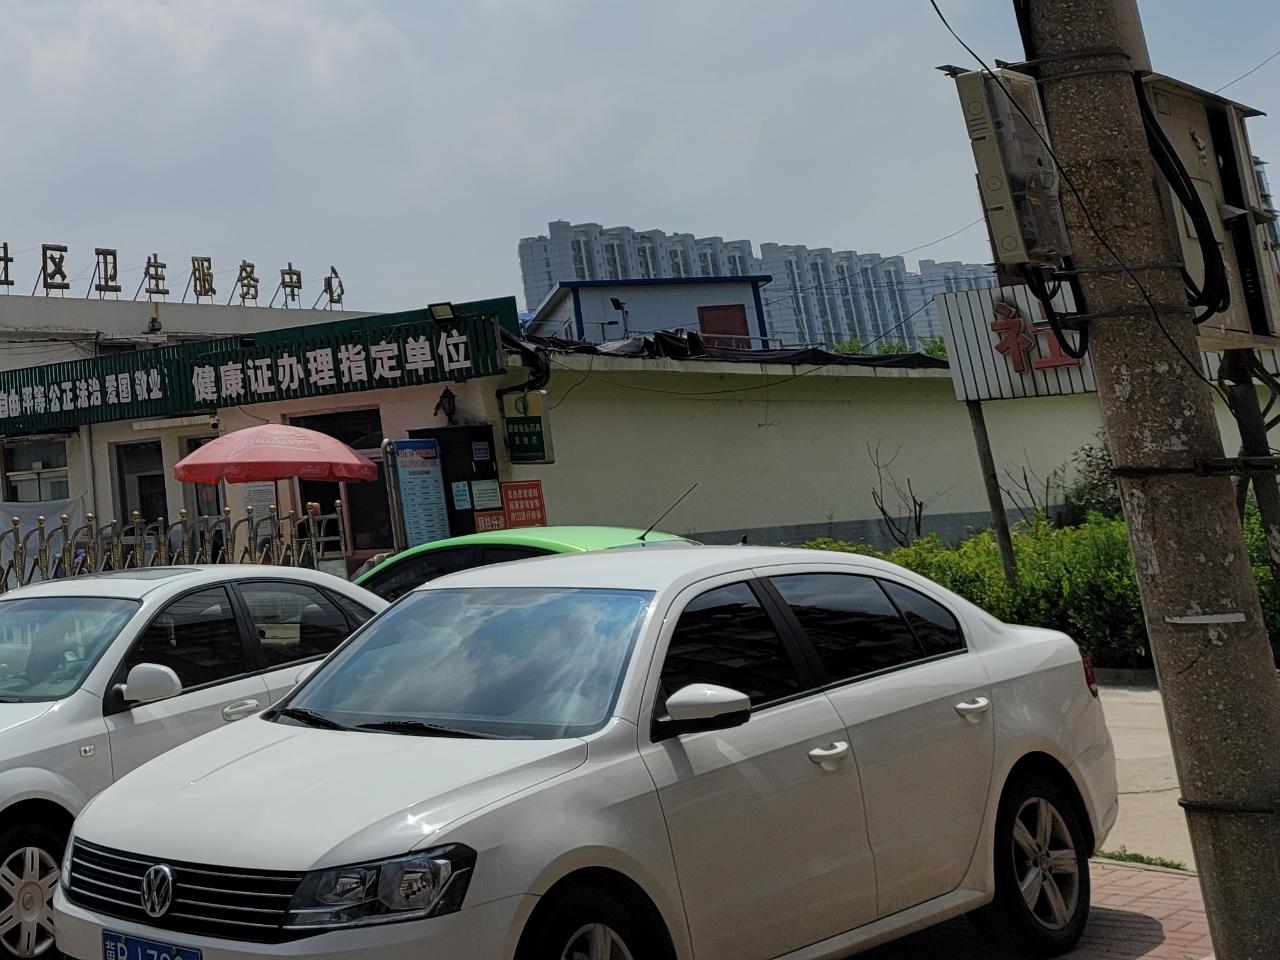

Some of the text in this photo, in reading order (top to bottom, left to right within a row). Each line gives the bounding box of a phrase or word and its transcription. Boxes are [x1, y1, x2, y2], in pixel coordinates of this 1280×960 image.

[191, 328, 472, 403] 健康证办理指定单位
